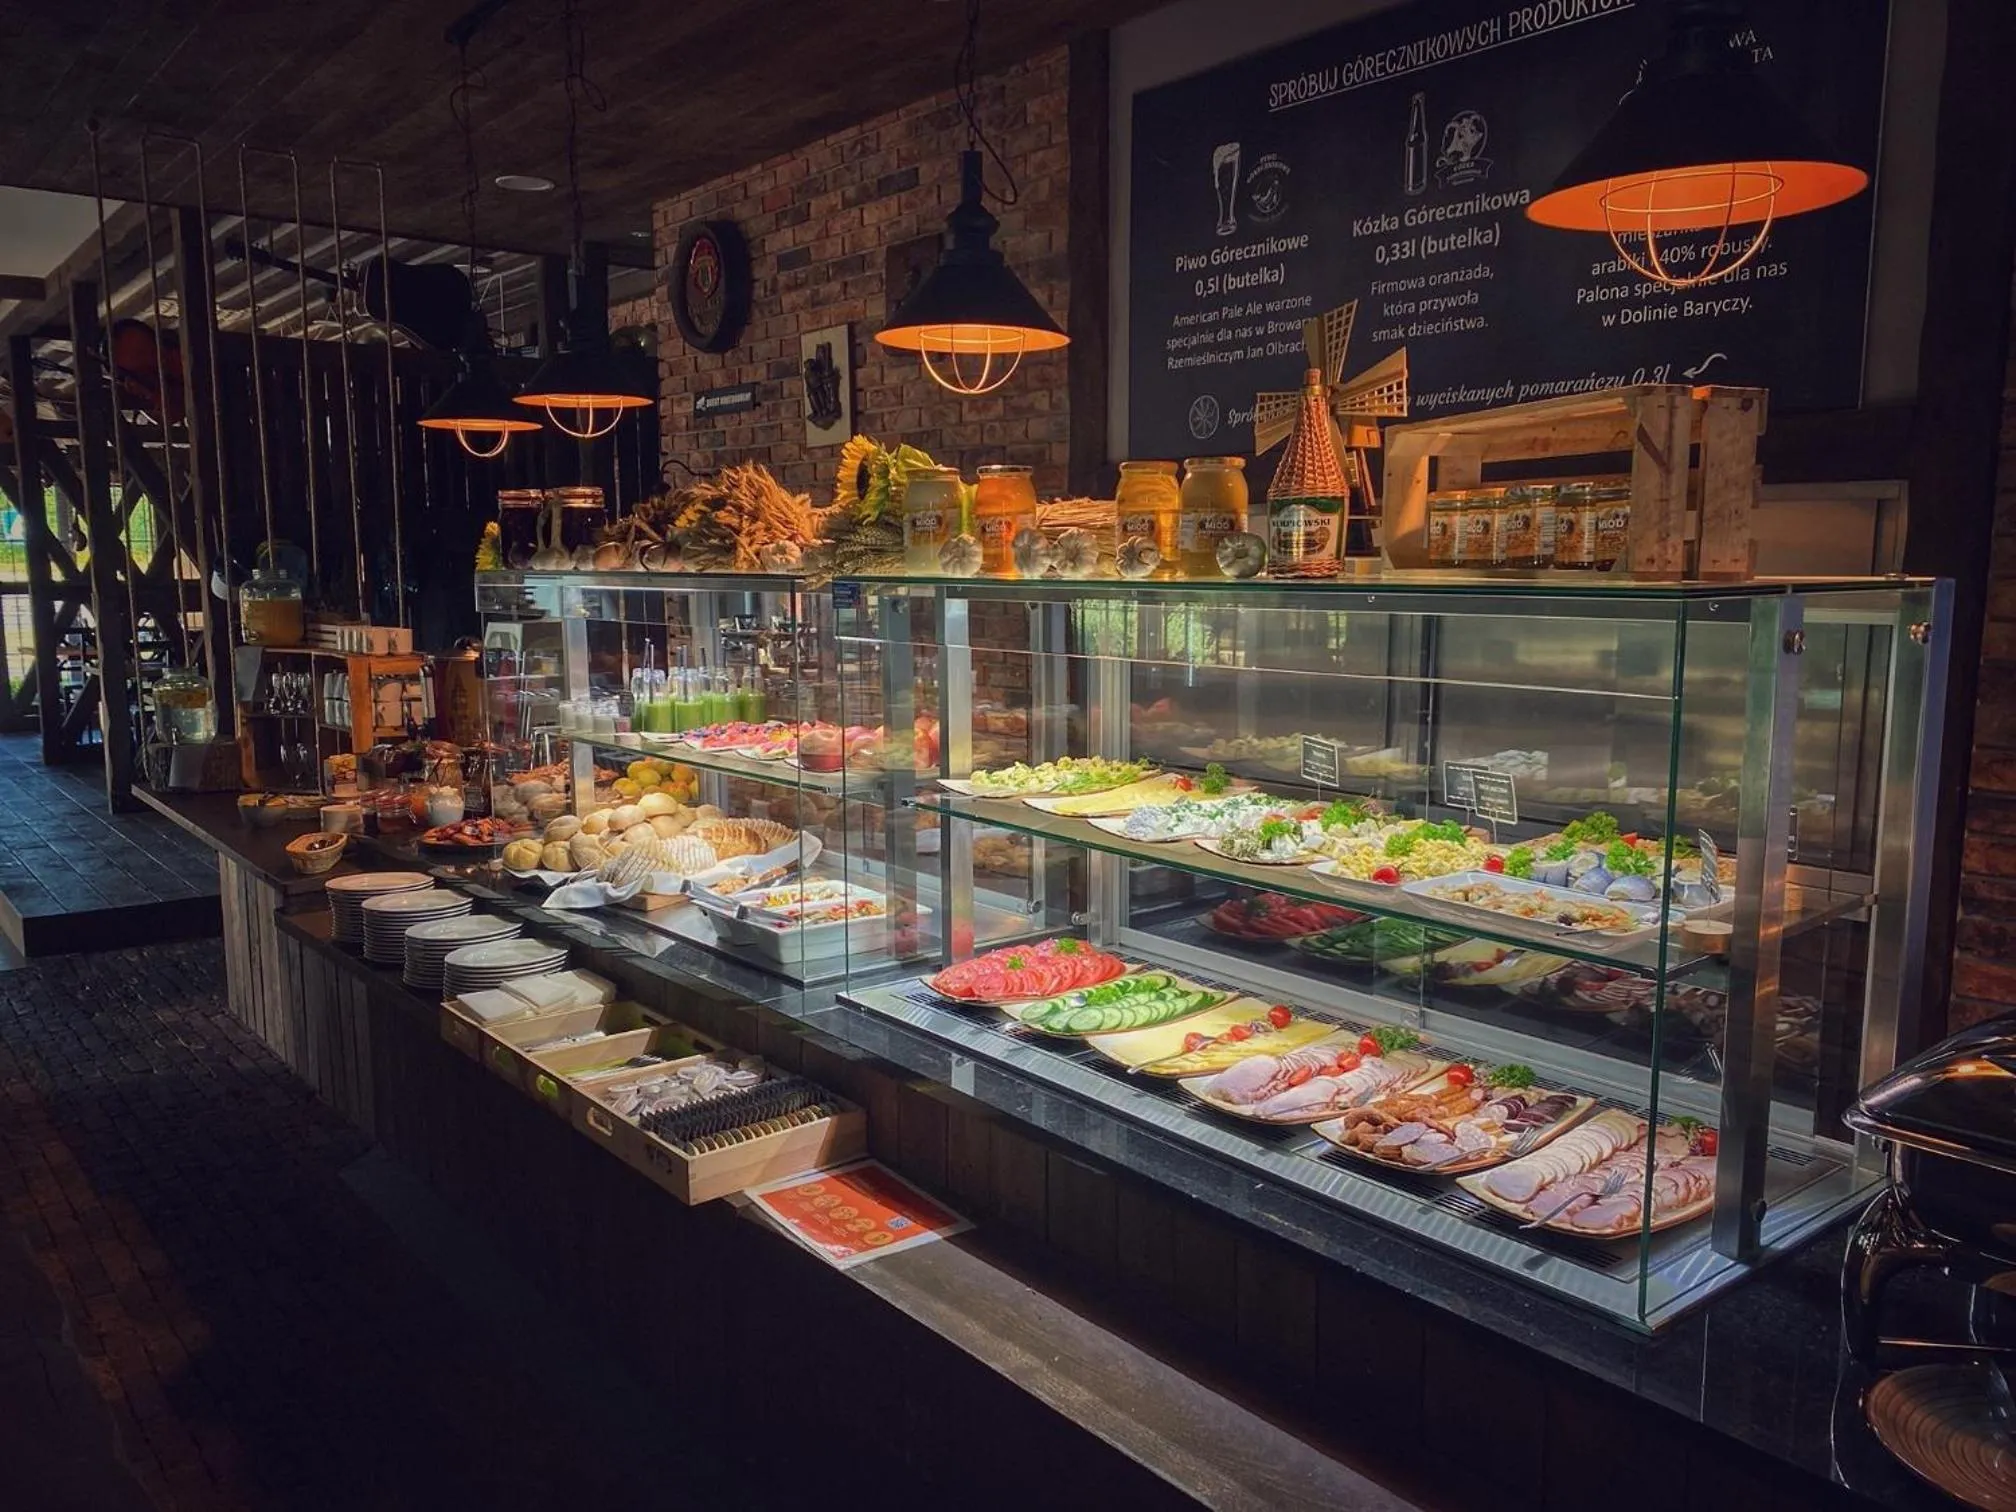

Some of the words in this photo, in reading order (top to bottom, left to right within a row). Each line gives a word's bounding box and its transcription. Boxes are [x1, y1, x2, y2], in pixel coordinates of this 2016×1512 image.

[1269, 66, 1338, 107] SPRÓBUJ
[1343, 16, 1501, 87] GÓRECZNIKOWYCH
[1353, 214, 1399, 237] Kózka
[1404, 189, 1530, 226] Górecznikowa
[1175, 254, 1207, 272] Piwo
[1210, 234, 1309, 266] Górecznikowe
[1375, 238, 1416, 265] 0,33l
[1421, 222, 1501, 259] (butelka)
[1660, 243, 1696, 264] 40%
[1195, 277, 1219, 297] 0,5l
[1223, 263, 1285, 294] (butelka)
[1370, 277, 1425, 296] Firmowa
[1429, 263, 1494, 287] oranżada,
[1577, 284, 1629, 304] Palona
[1756, 260, 1788, 278] nas
[1173, 310, 1219, 328] American
[1222, 304, 1243, 321] Pale
[1245, 302, 1263, 315] Ale
[1265, 295, 1312, 312] warzone
[1383, 300, 1415, 318] która
[1419, 290, 1479, 315] przywoła
[1601, 314, 1616, 328] w
[1620, 304, 1678, 325] Dolinie
[1684, 296, 1753, 318] Baryczy.
[1166, 331, 1215, 351] specjalnie
[1217, 327, 1233, 342] dla
[1235, 325, 1253, 339] nas
[1255, 326, 1265, 336] w
[1371, 325, 1405, 342] smak
[1408, 315, 1489, 337] dzieciństwa.
[1167, 350, 1244, 370] Rzemieślniczym
[1246, 345, 1263, 360] Jan
[1416, 381, 1514, 411] wyciskanych
